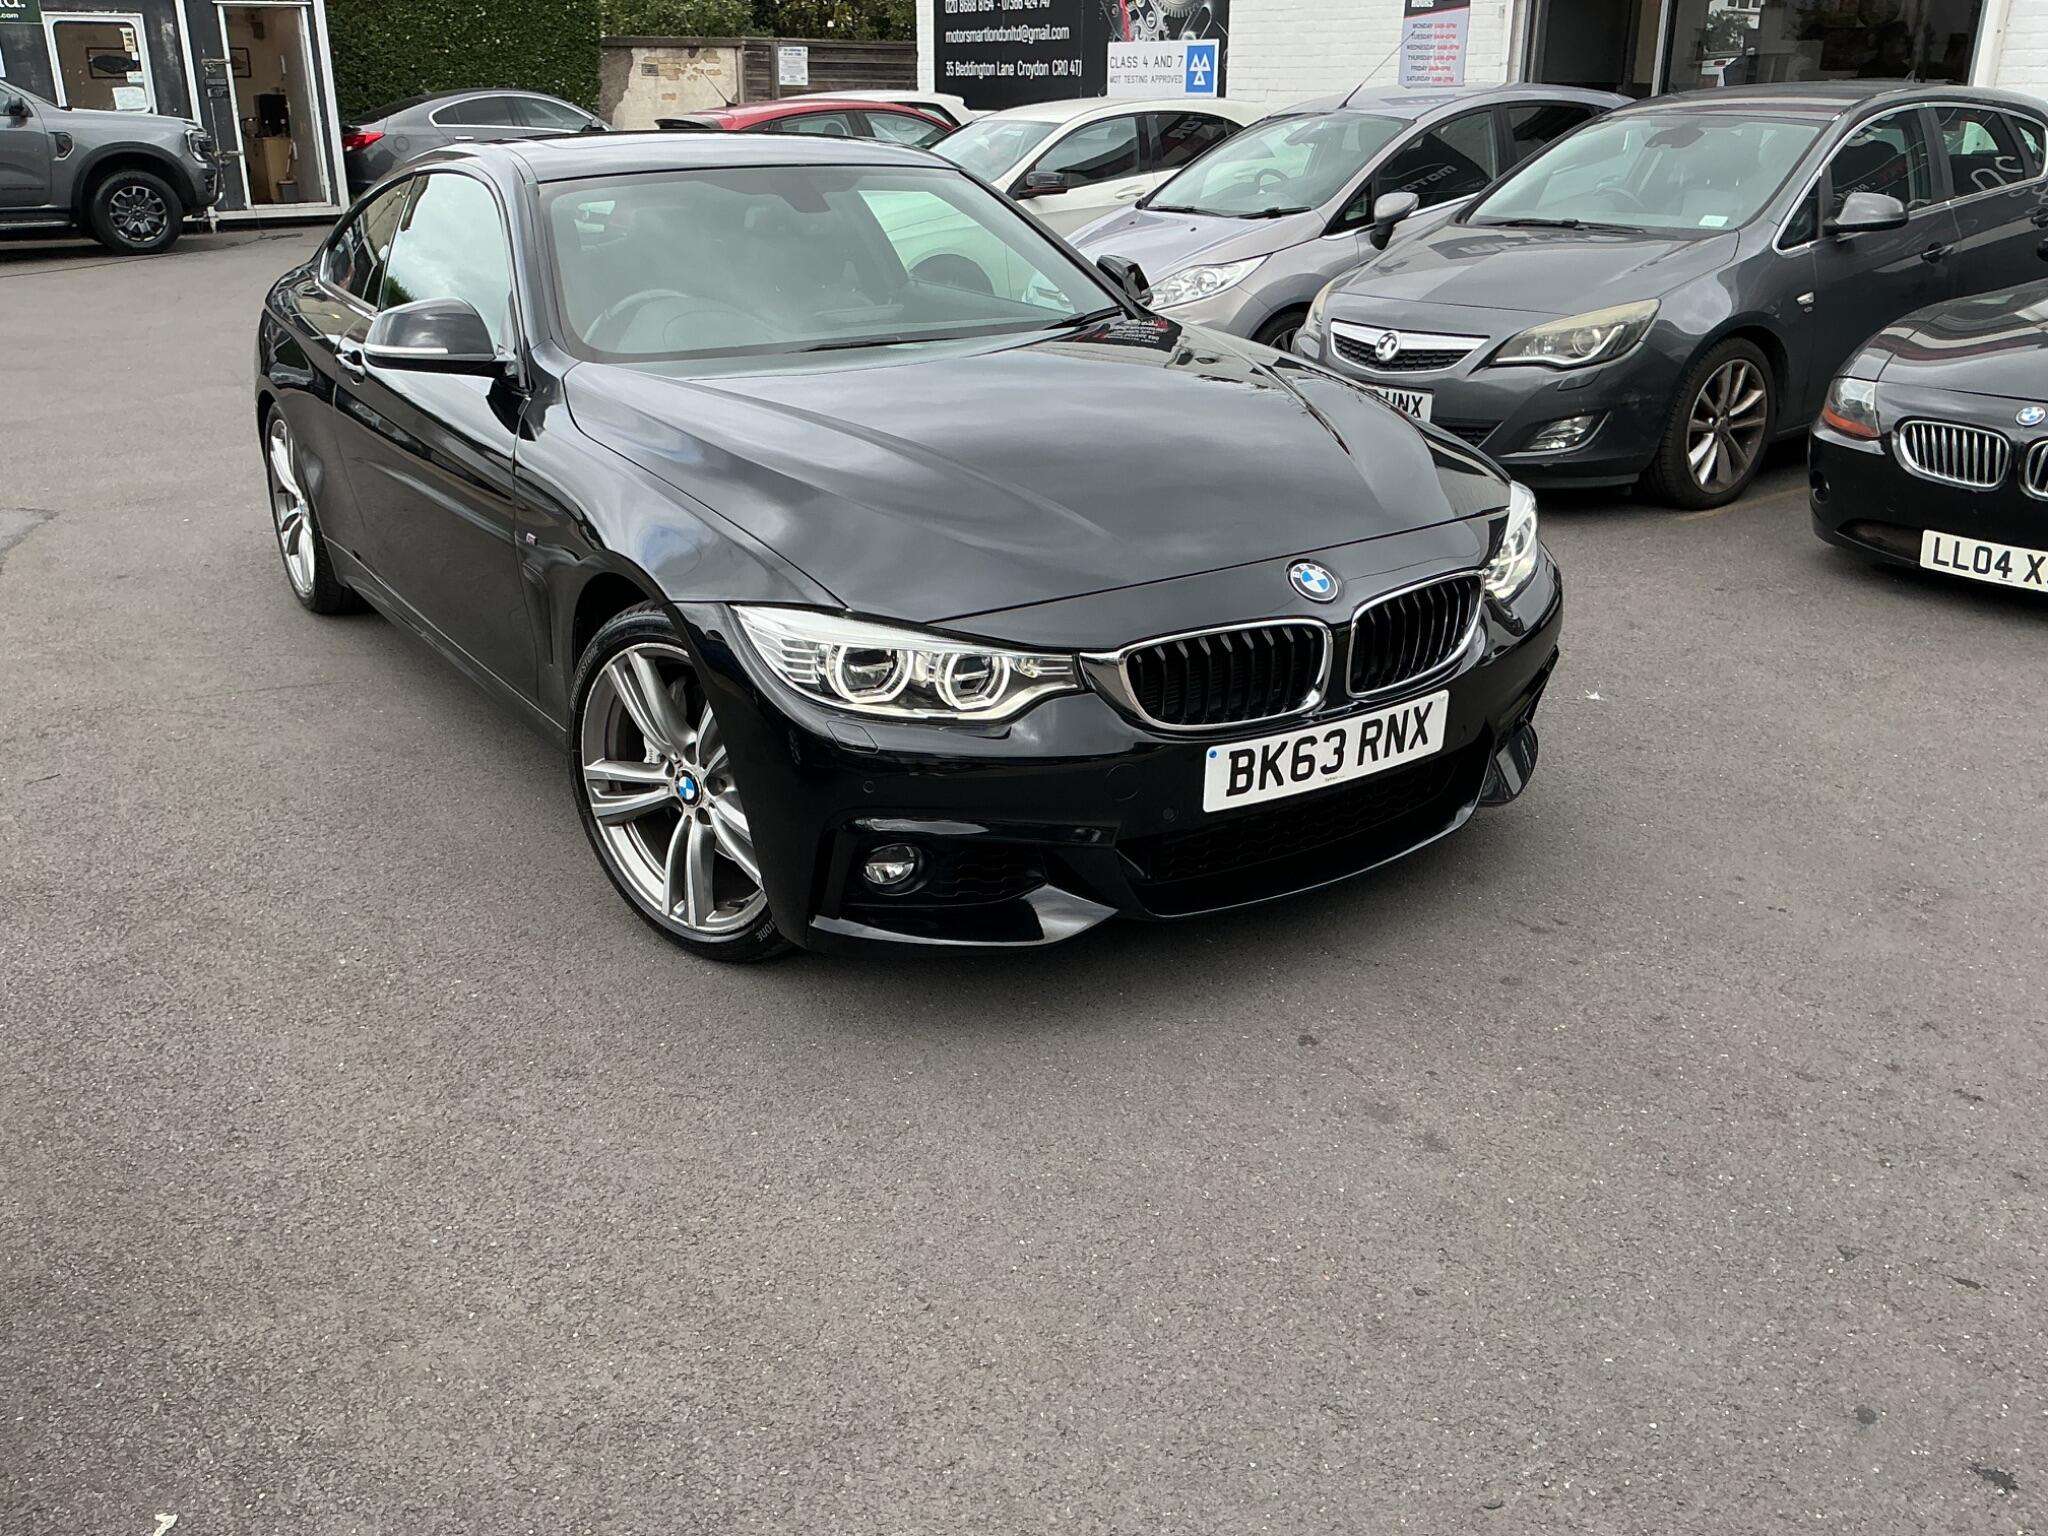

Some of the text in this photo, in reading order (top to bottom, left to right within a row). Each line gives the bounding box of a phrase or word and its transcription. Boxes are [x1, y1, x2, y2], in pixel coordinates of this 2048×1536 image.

[945, 24, 1070, 44] motorsmartlondonltd@gmail.com
[955, 60, 995, 79] Beddington
[996, 61, 1014, 76] Lane
[1017, 60, 1049, 79] Croydon
[1109, 55, 1184, 69] CLASS 4 AND 7
[1124, 74, 1148, 84] TESTING
[1151, 74, 1184, 84] APPROVED
[2023, 554, 2048, 585] X
[1225, 701, 1434, 797] BK63 RNX
